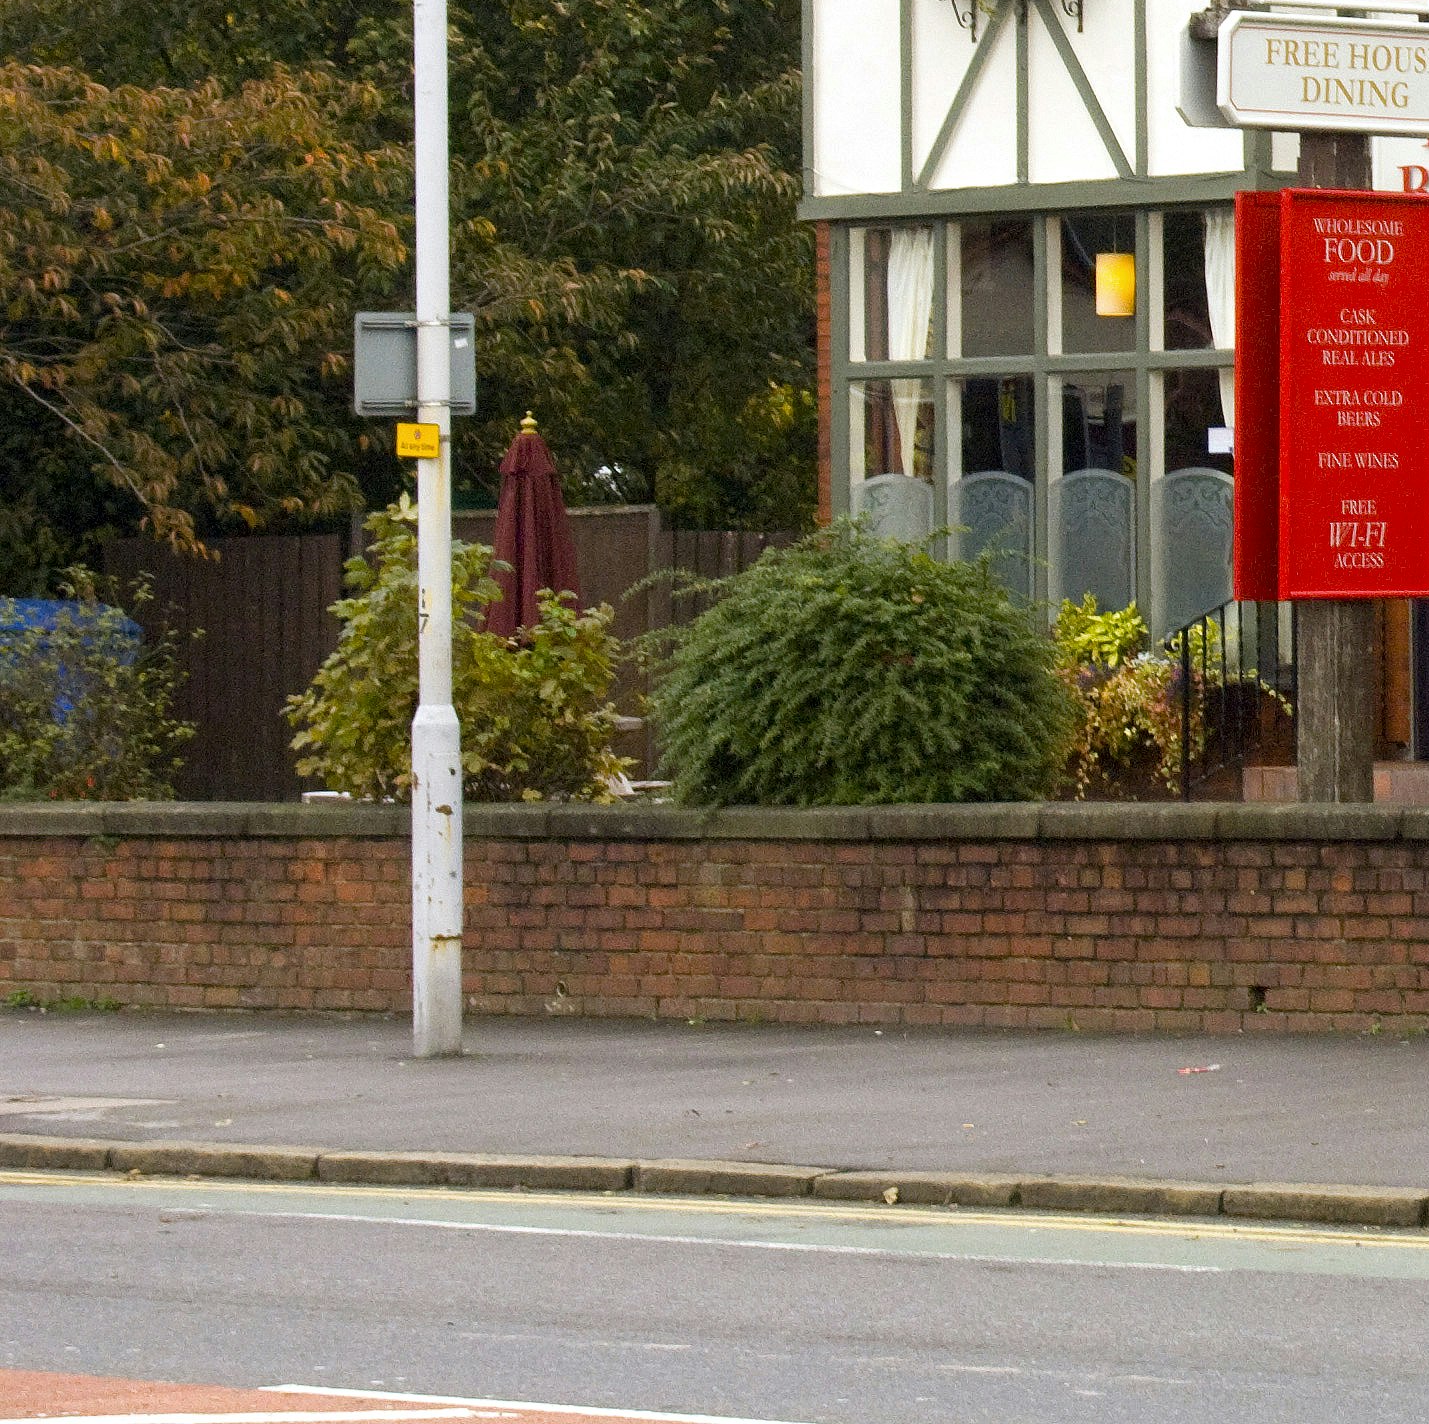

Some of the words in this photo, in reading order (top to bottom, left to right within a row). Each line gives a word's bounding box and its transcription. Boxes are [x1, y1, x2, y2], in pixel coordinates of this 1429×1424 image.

[1265, 38, 1339, 68] FREE
[1301, 76, 1409, 108] DINING
[1313, 218, 1404, 236] WHOLESOME
[1324, 238, 1394, 265] FOOD
[1358, 267, 1372, 282] all
[1373, 269, 1389, 286] day
[1340, 308, 1376, 324] CASK
[1307, 328, 1410, 345] CONDITIONED
[1322, 350, 1358, 366] REAL
[1361, 350, 1395, 367] ALES
[1314, 390, 1360, 406] EXTRA
[1363, 390, 1402, 406] COLD
[1337, 411, 1380, 427] BEERS
[1318, 452, 1352, 468] FINE
[1355, 452, 1399, 469] WINES
[1341, 500, 1376, 515] FREE
[1329, 521, 1387, 548] WI-FI
[1335, 552, 1384, 568] ACCESS
